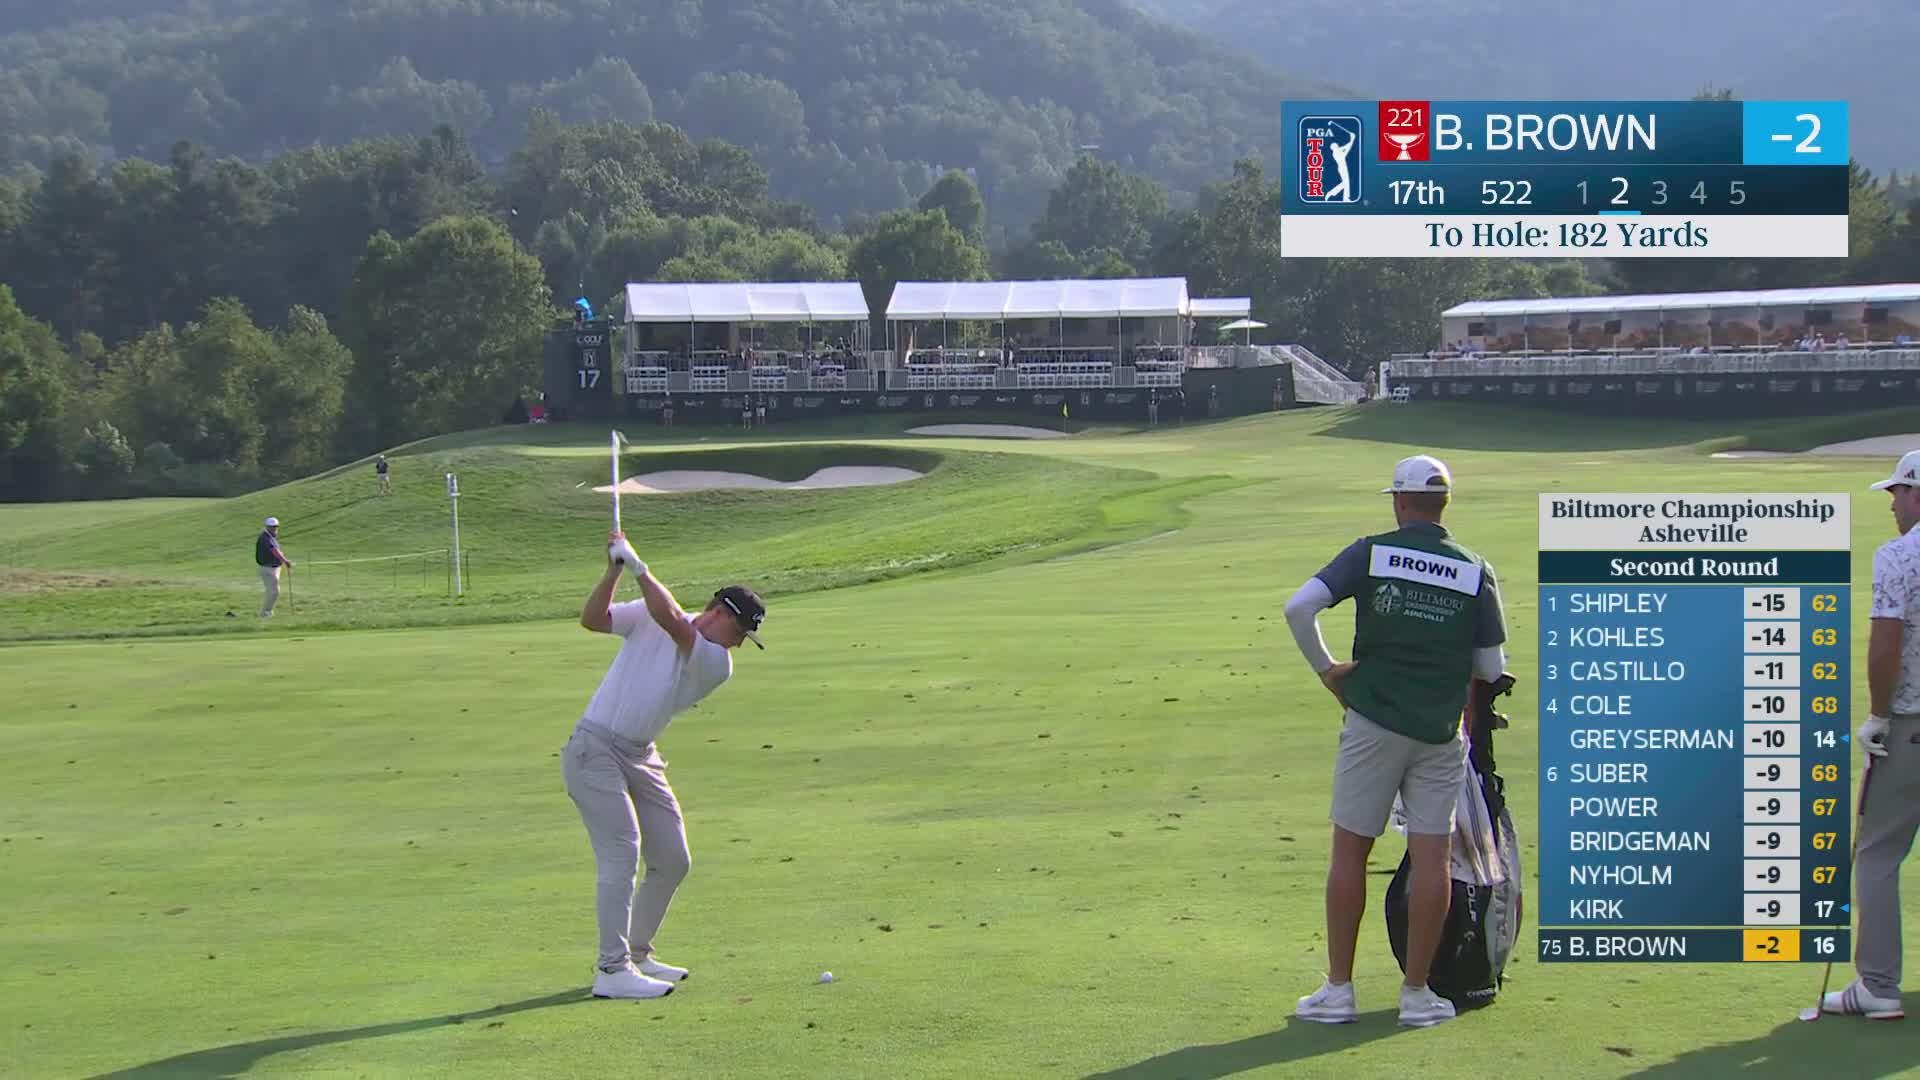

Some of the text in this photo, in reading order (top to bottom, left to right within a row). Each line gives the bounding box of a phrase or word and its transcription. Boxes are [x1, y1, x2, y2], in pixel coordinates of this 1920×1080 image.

[578, 369, 600, 388] 17
[1389, 555, 1458, 580] BROWN
[1465, 884, 1477, 922] OLF
